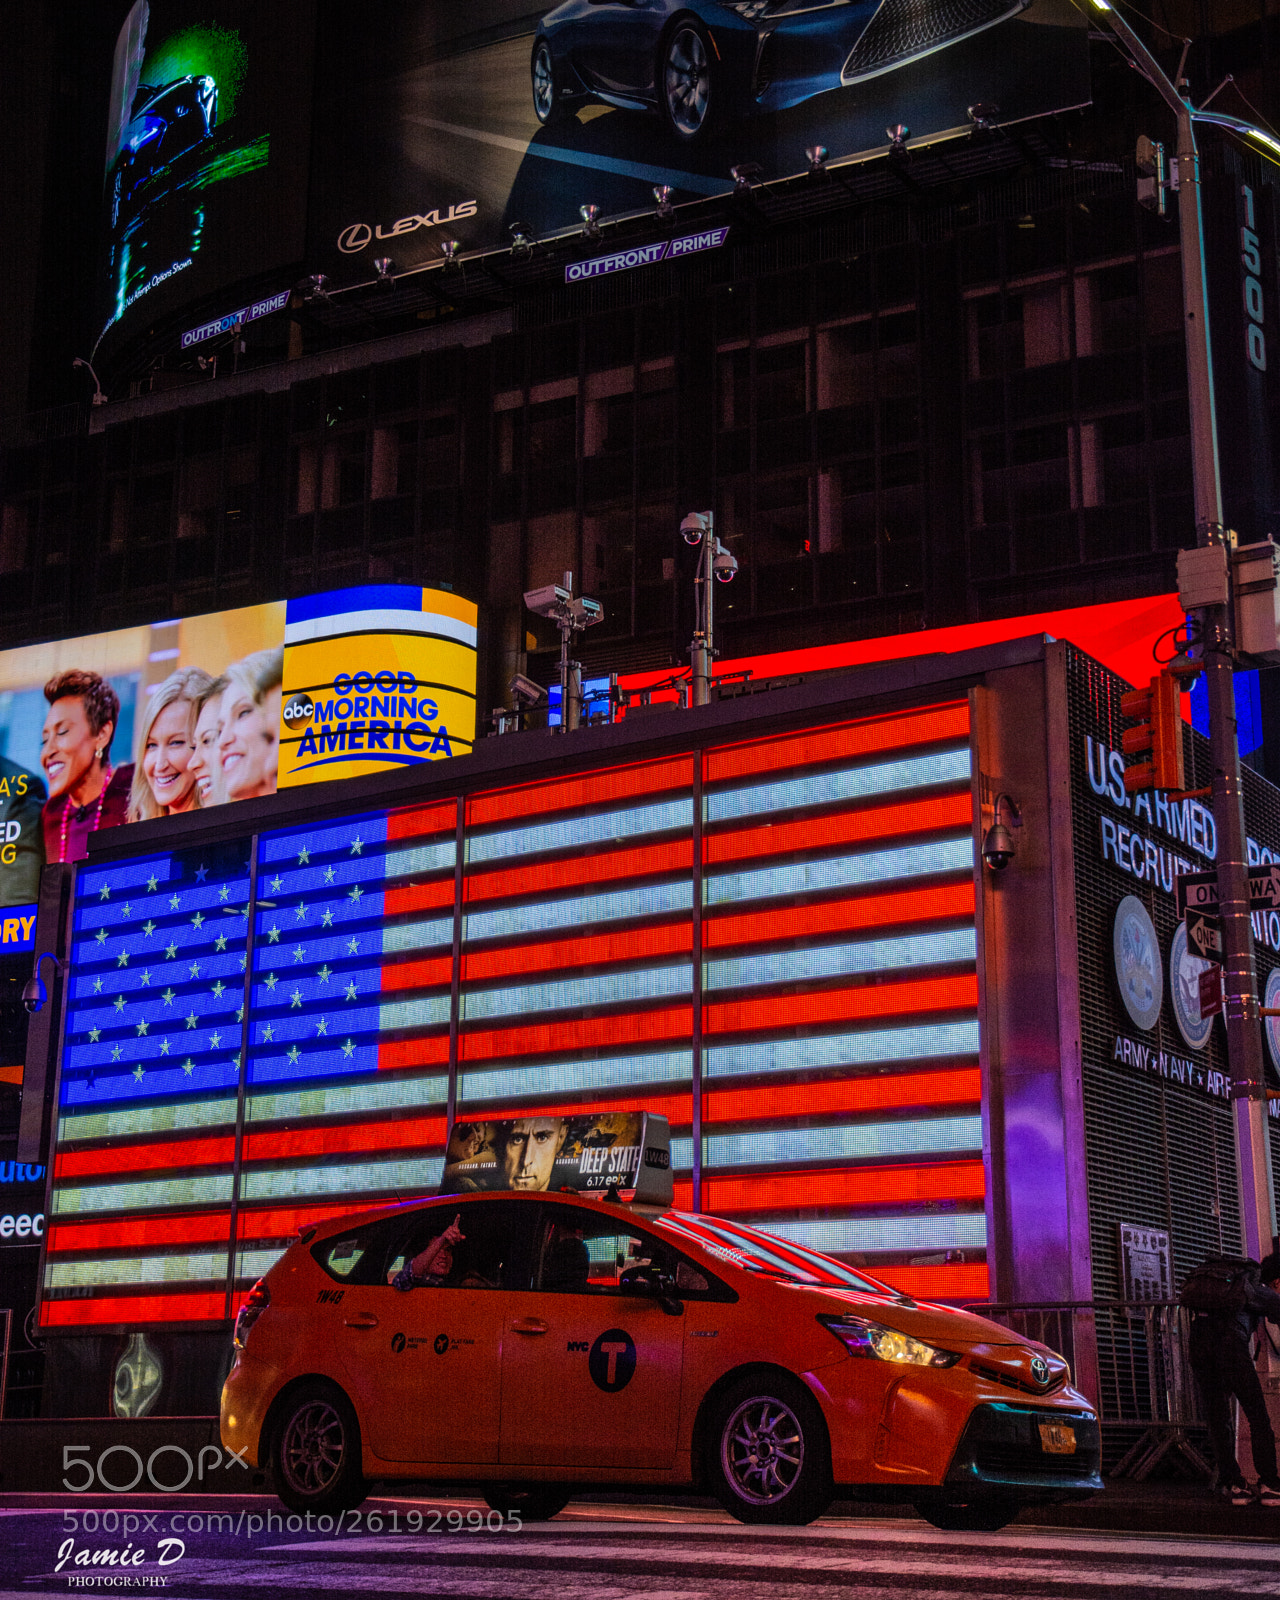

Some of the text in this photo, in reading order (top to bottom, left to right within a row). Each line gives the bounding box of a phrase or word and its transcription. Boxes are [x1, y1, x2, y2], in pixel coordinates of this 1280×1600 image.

[375, 200, 478, 240] LEXUS
[568, 231, 723, 280] OUTFRONT PRIME
[151, 272, 173, 287] Options
[1241, 184, 1267, 372] 1500
[183, 294, 286, 346] OUTFRONT PRIME
[333, 670, 418, 696] GOOD
[283, 702, 314, 719] abc
[314, 696, 439, 724] MORNING
[296, 720, 453, 758] AMERICA
[1084, 734, 1131, 809] U.S.
[1134, 789, 1218, 861] ARMED
[1196, 886, 1220, 903] ON
[0, 915, 36, 944] RY
[1196, 926, 1216, 950] ONE
[1114, 1035, 1150, 1072] ARMY
[1159, 1051, 1194, 1087] NAVY
[1206, 1069, 1225, 1097] AIR
[579, 1145, 641, 1174] DEEP STATE
[644, 1149, 670, 1165] 1W48
[586, 1175, 605, 1187] 6.17
[567, 1341, 590, 1352] NYC
